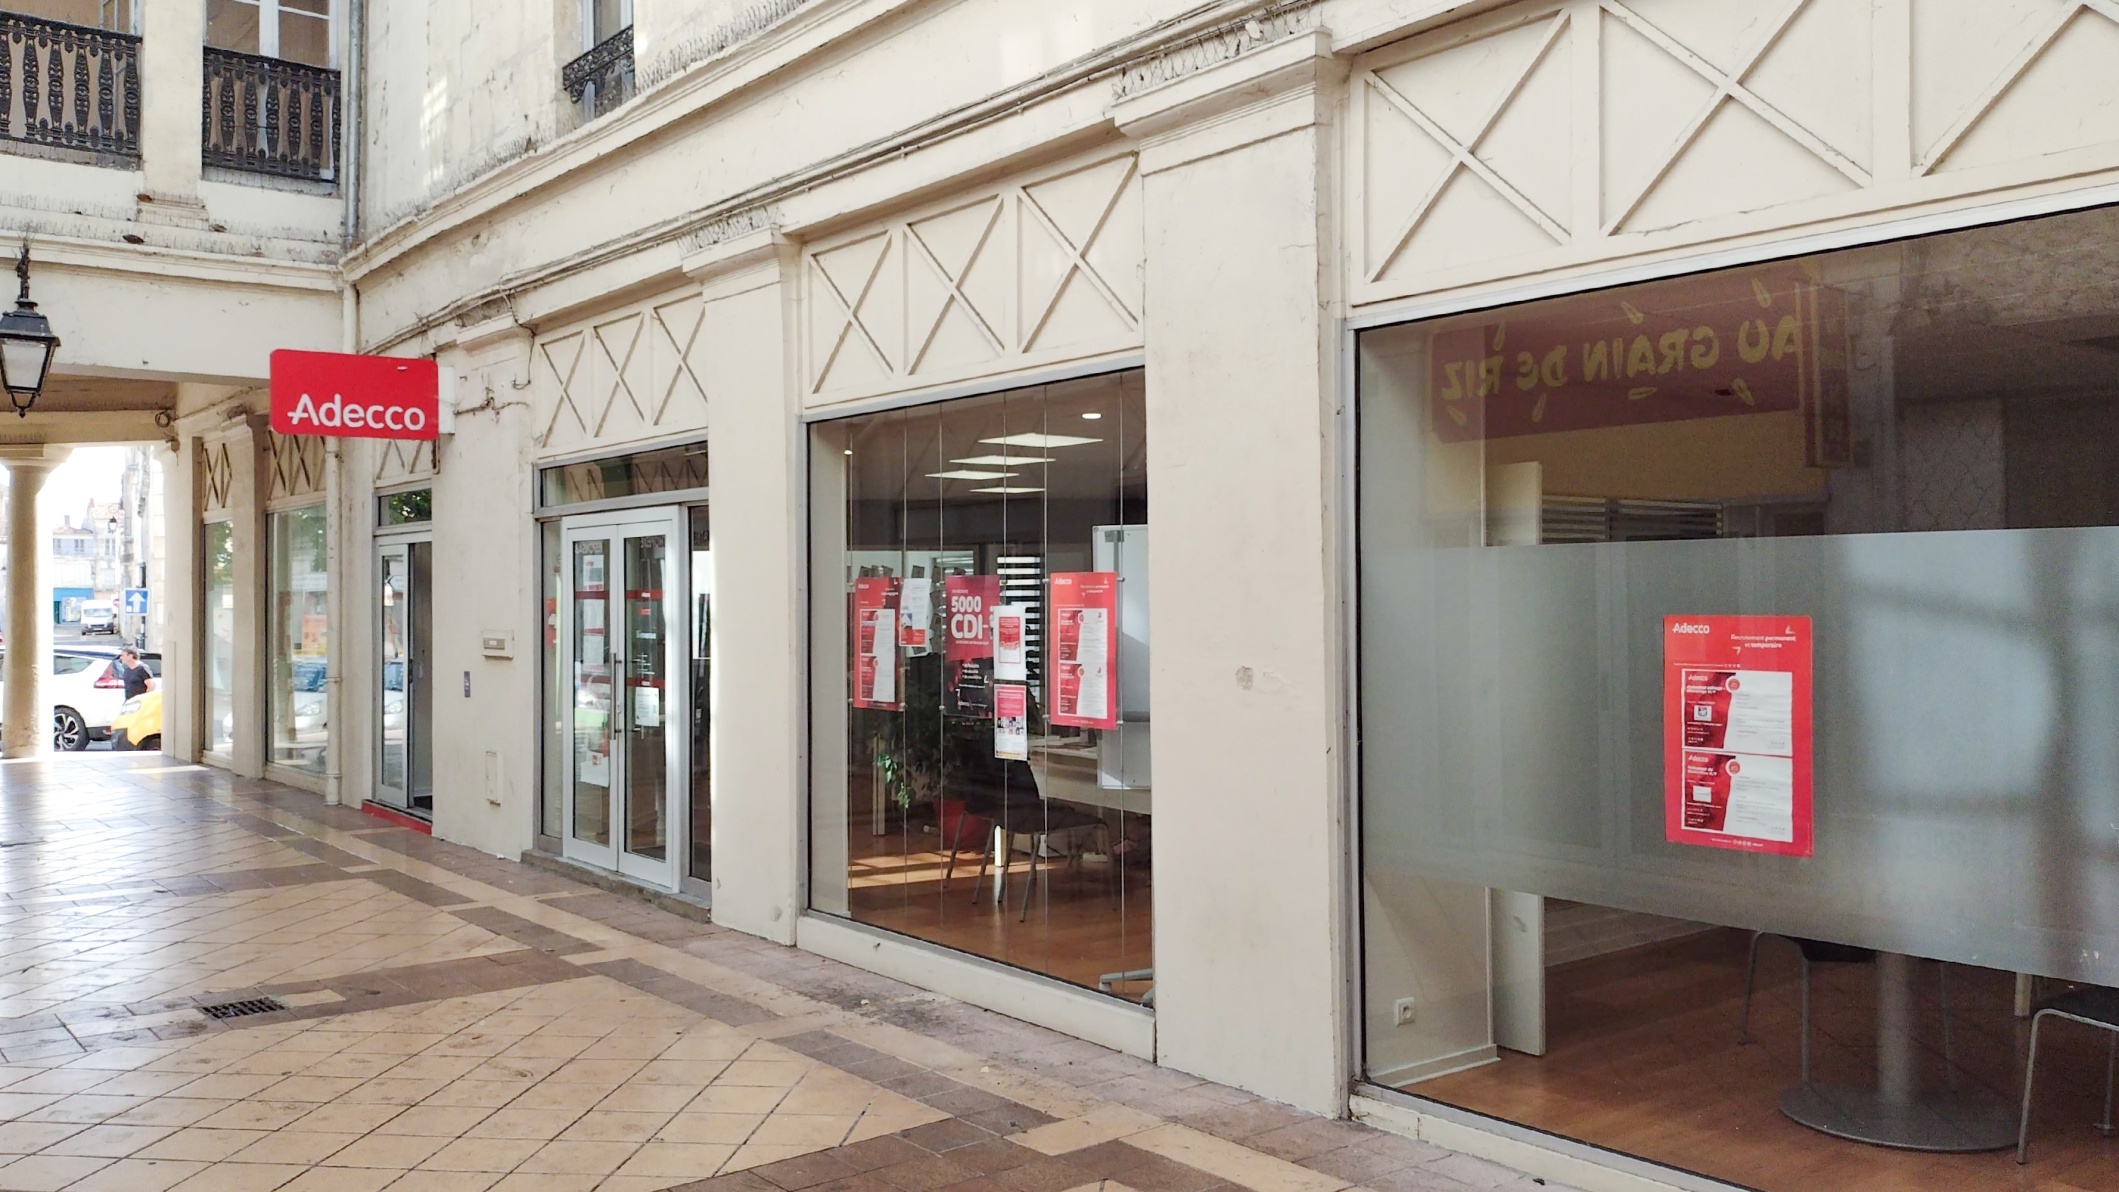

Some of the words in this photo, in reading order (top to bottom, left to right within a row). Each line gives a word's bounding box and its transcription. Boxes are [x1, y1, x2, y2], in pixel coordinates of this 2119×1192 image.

[287, 393, 426, 431] Adecco
[951, 595, 982, 613] 5000
[1672, 622, 1710, 634] Adecco
